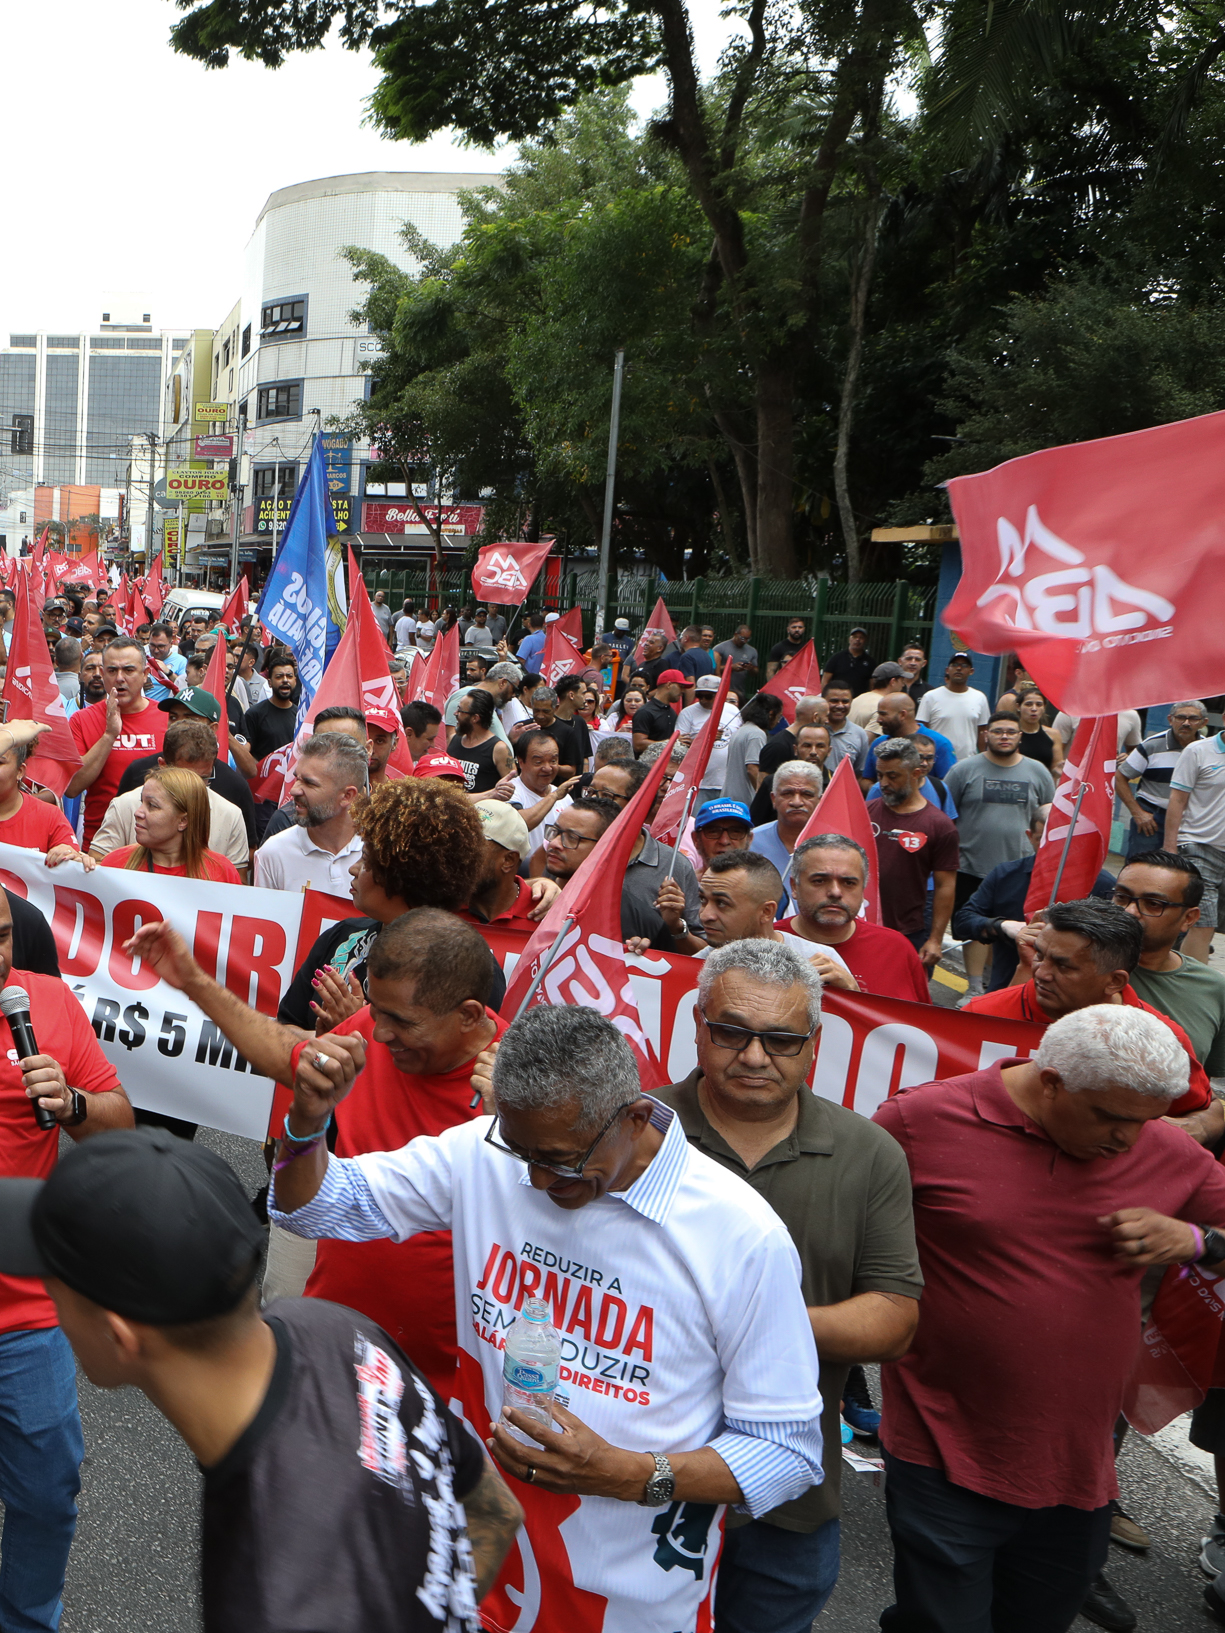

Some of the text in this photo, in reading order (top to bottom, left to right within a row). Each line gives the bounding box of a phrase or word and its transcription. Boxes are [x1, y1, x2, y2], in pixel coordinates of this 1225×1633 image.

[169, 479, 225, 490] OURO
[259, 511, 291, 520] ACIENT
[385, 508, 421, 522] Bella
[167, 531, 182, 554] OURO
[11, 676, 33, 700] SINDICA
[985, 781, 1022, 792] GANG
[901, 836, 920, 849] 13
[50, 884, 287, 1019] DO IR
[91, 997, 150, 1051] R$
[157, 1010, 188, 1058] 5
[520, 1241, 624, 1295] REDUZIR A
[476, 1242, 654, 1363] JORNADA
[471, 1293, 651, 1387] SEM DUZIR
[559, 1365, 651, 1407] DIREITOS
